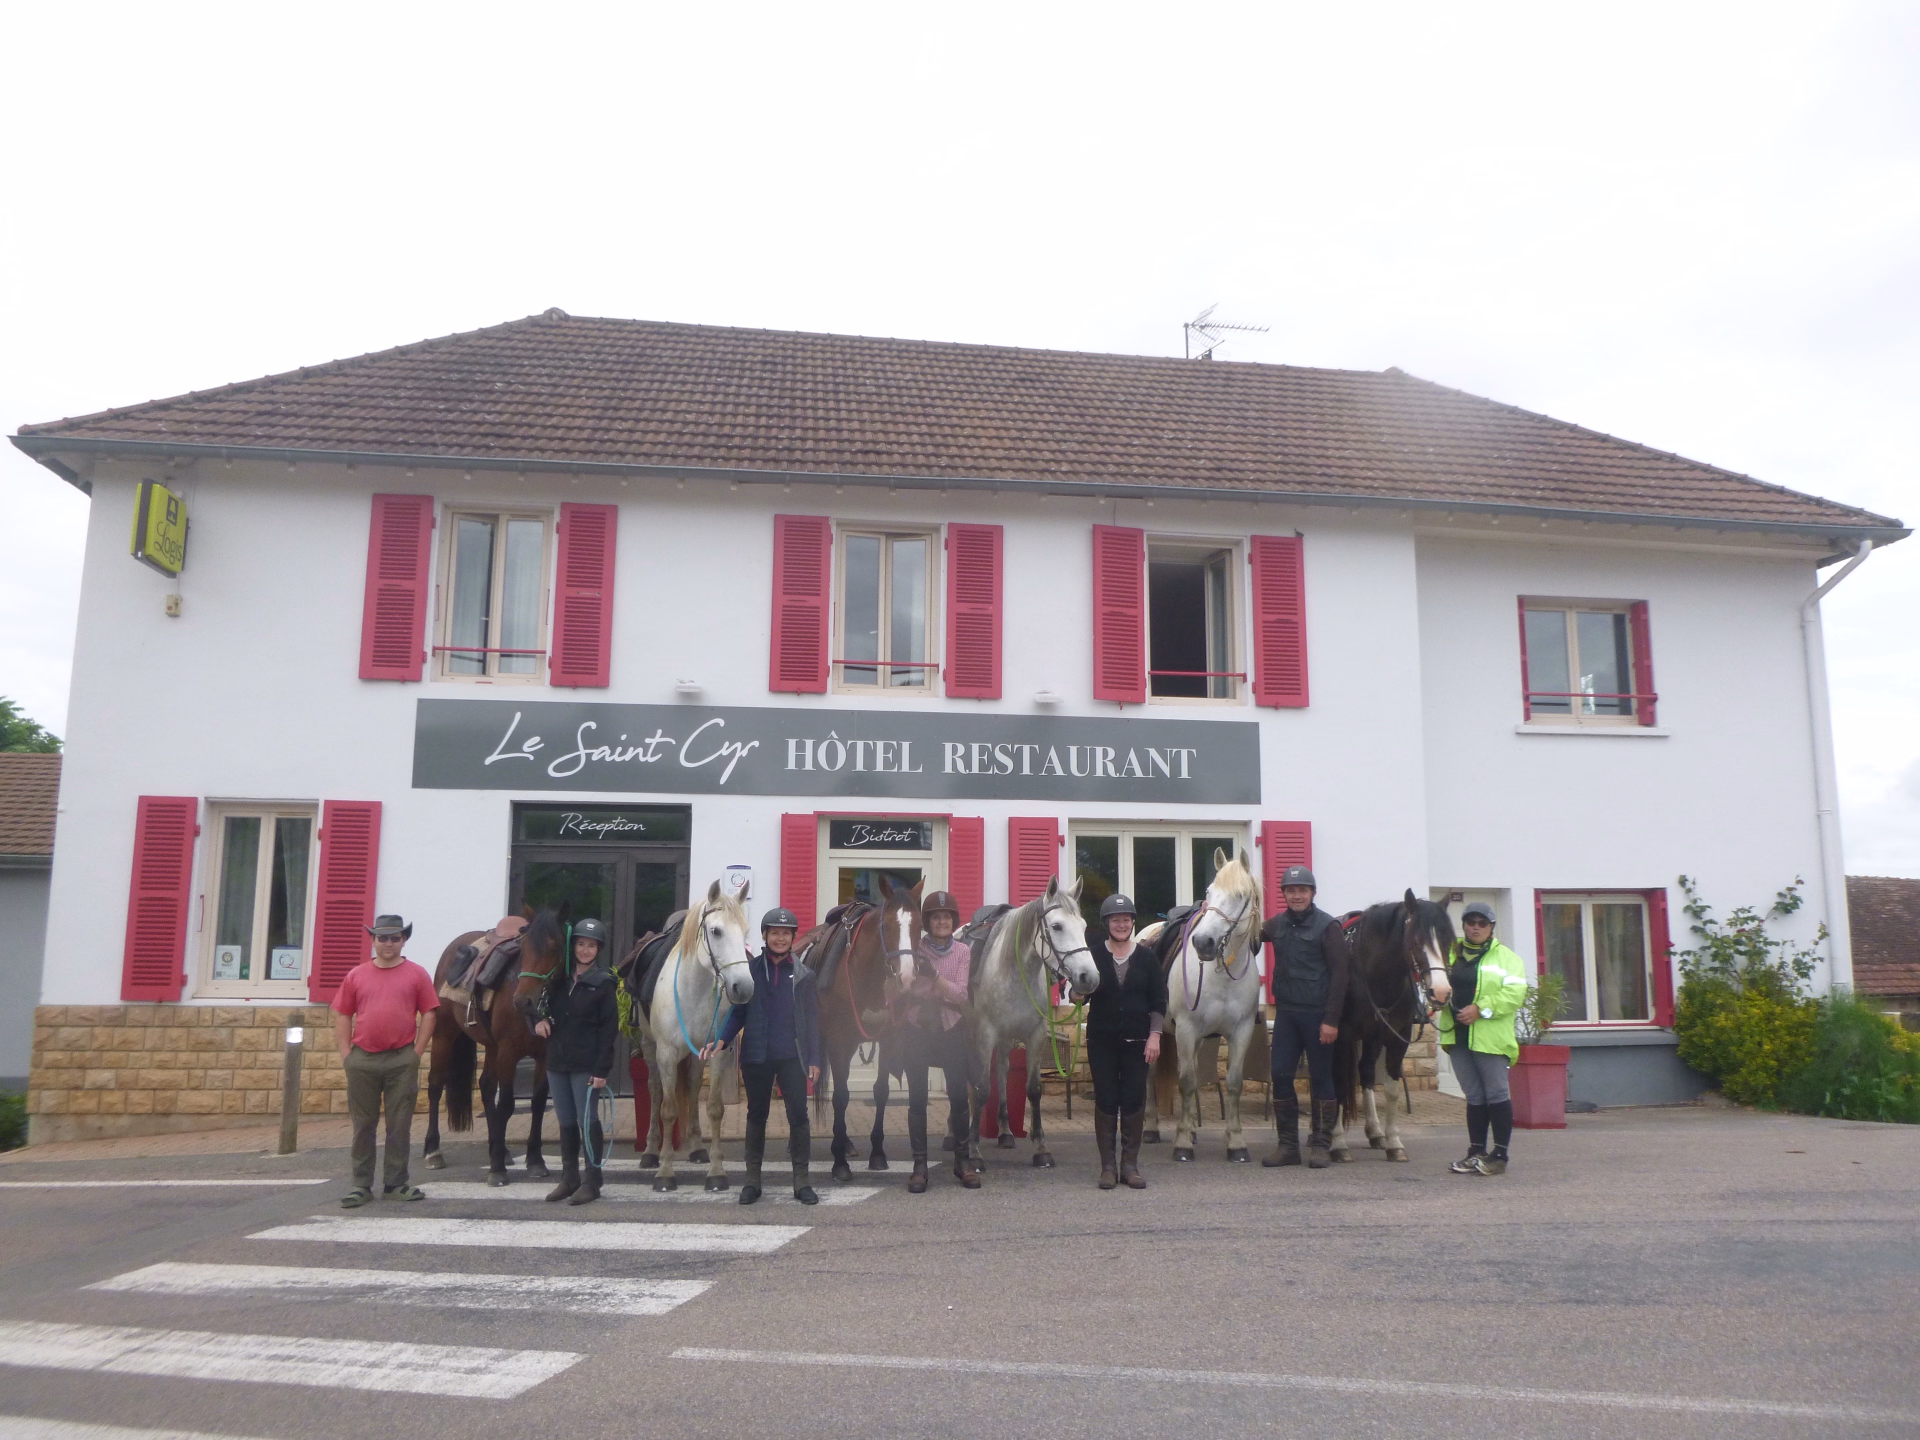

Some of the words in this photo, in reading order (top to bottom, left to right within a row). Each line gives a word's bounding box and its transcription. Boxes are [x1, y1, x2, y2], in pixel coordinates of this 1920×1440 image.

[154, 521, 183, 565] Logis
[485, 711, 545, 766] Le
[548, 721, 677, 779] Saint
[680, 717, 760, 785] Cyr
[784, 730, 923, 773] HÔTEL
[942, 742, 1197, 779] RESTAURANT
[559, 812, 646, 840] Réception
[844, 824, 918, 847] Bistrot
